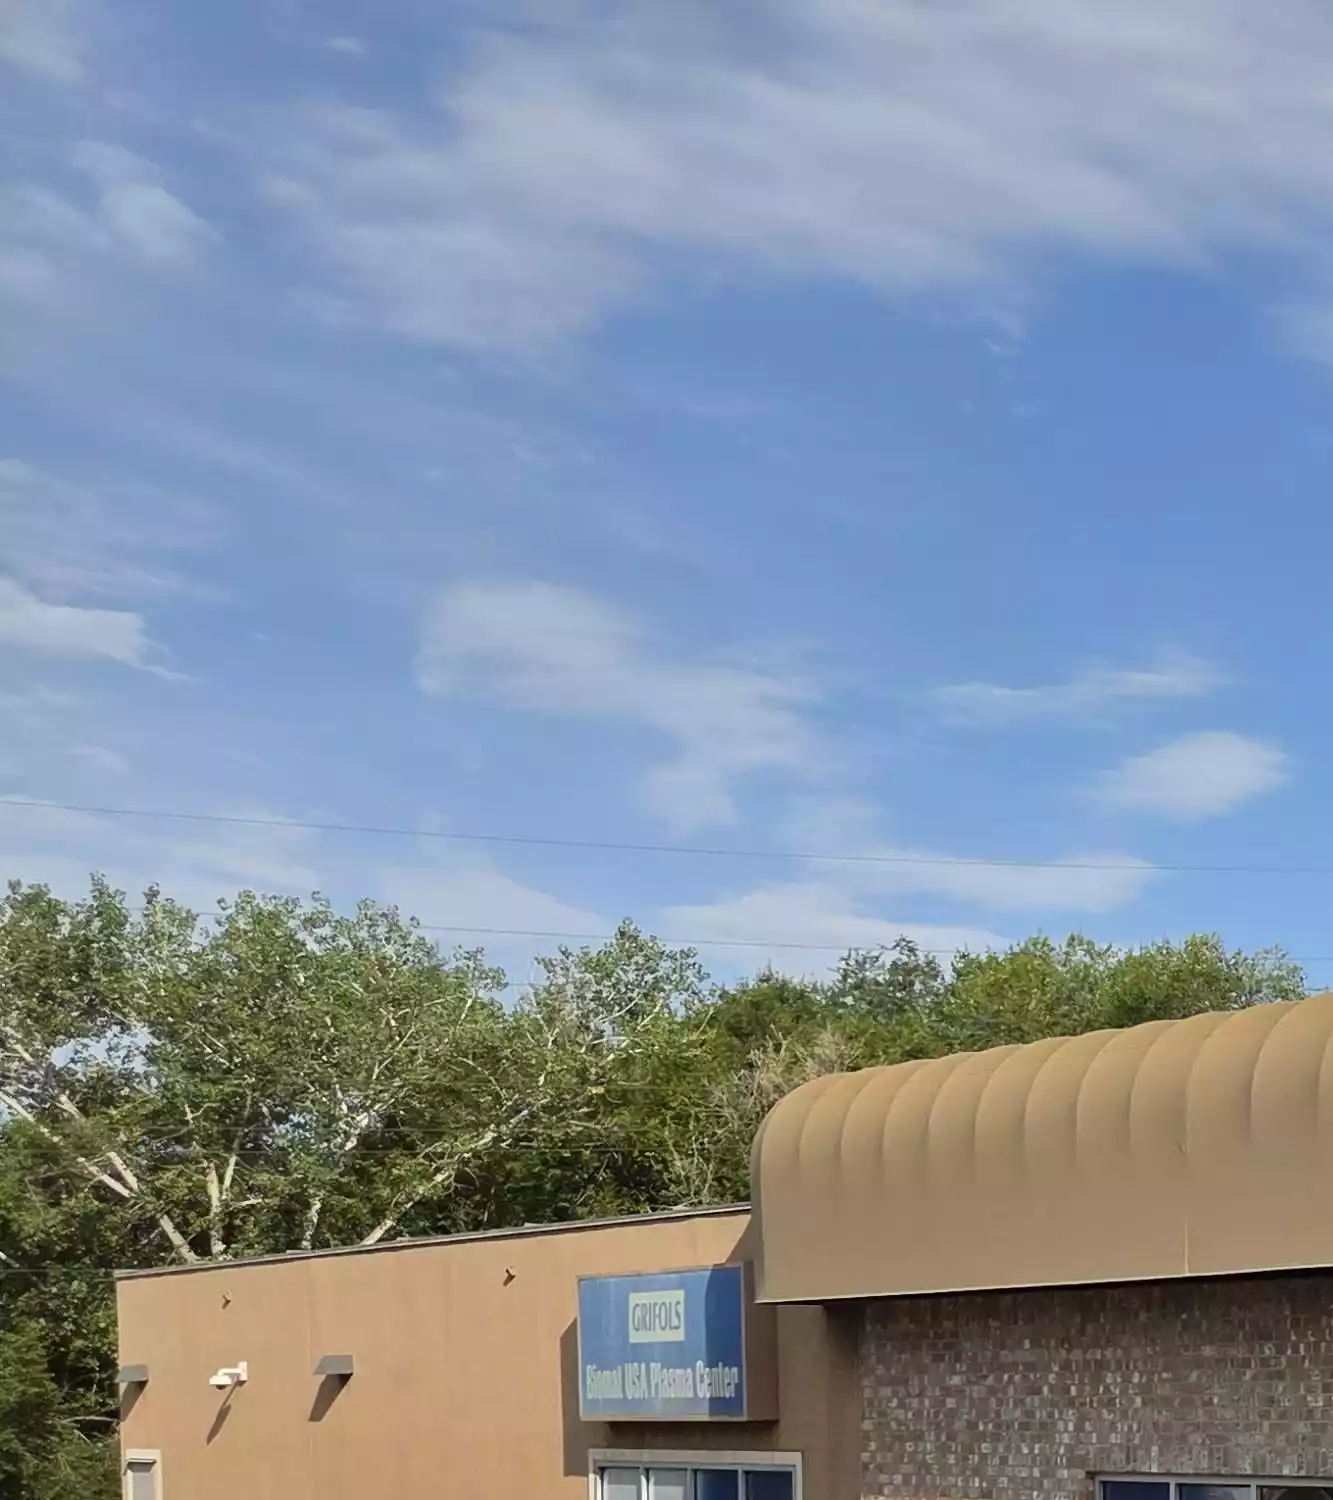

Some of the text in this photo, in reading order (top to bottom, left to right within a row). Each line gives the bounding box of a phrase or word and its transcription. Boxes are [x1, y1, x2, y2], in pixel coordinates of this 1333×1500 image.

[631, 1300, 682, 1333] GRIFOLS
[586, 1359, 740, 1400] Biomat USA Plasma Center
